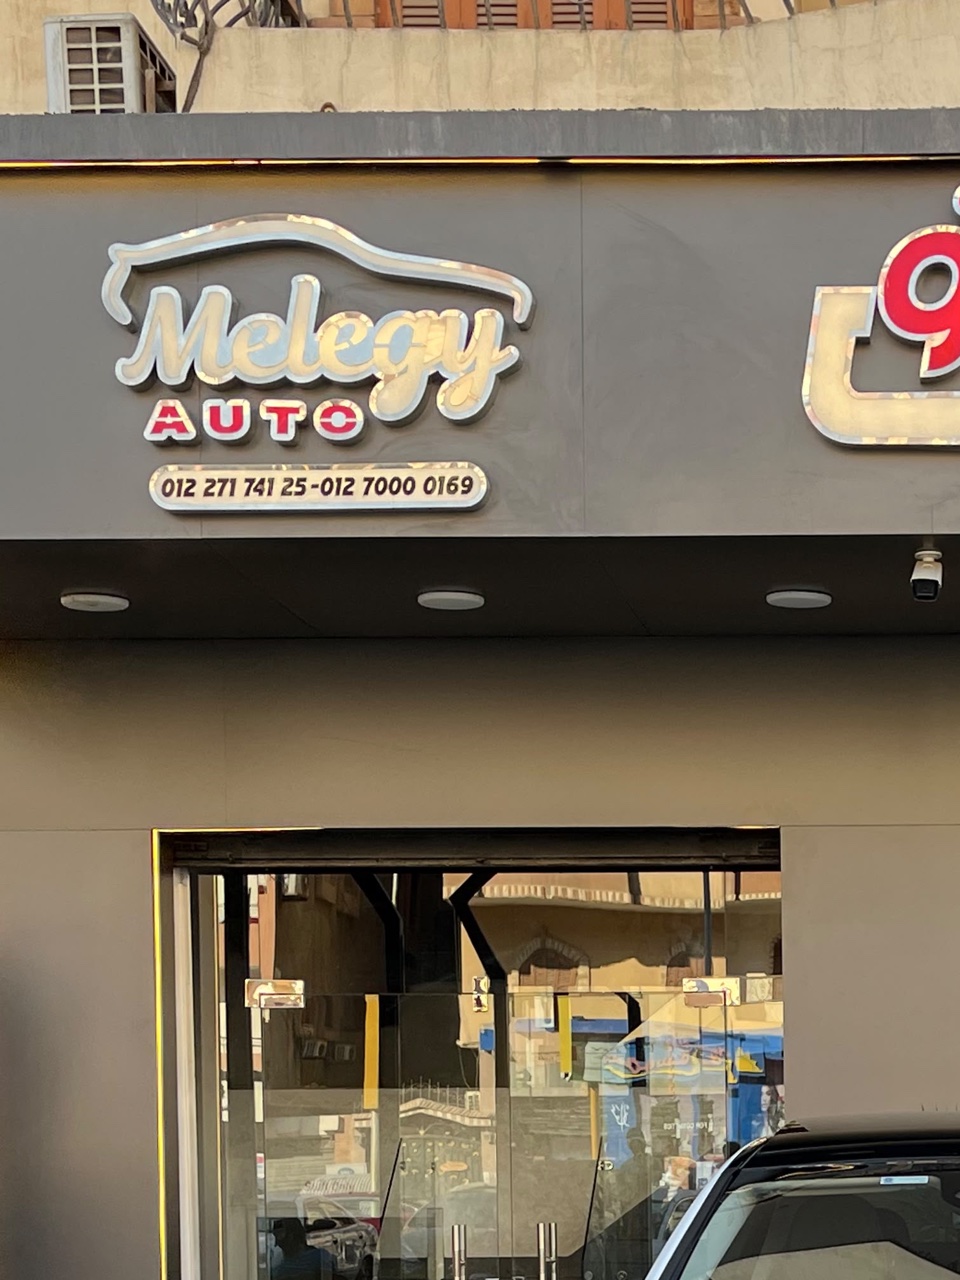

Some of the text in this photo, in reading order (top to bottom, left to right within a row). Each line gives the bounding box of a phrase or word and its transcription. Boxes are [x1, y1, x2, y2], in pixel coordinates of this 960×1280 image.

[114, 273, 522, 425] Melegy
[143, 398, 366, 443] AUTO
[161, 476, 198, 498] 012
[203, 476, 237, 497] 271
[243, 475, 277, 497] 741
[363, 475, 416, 496] 7000
[424, 475, 475, 496] 0169
